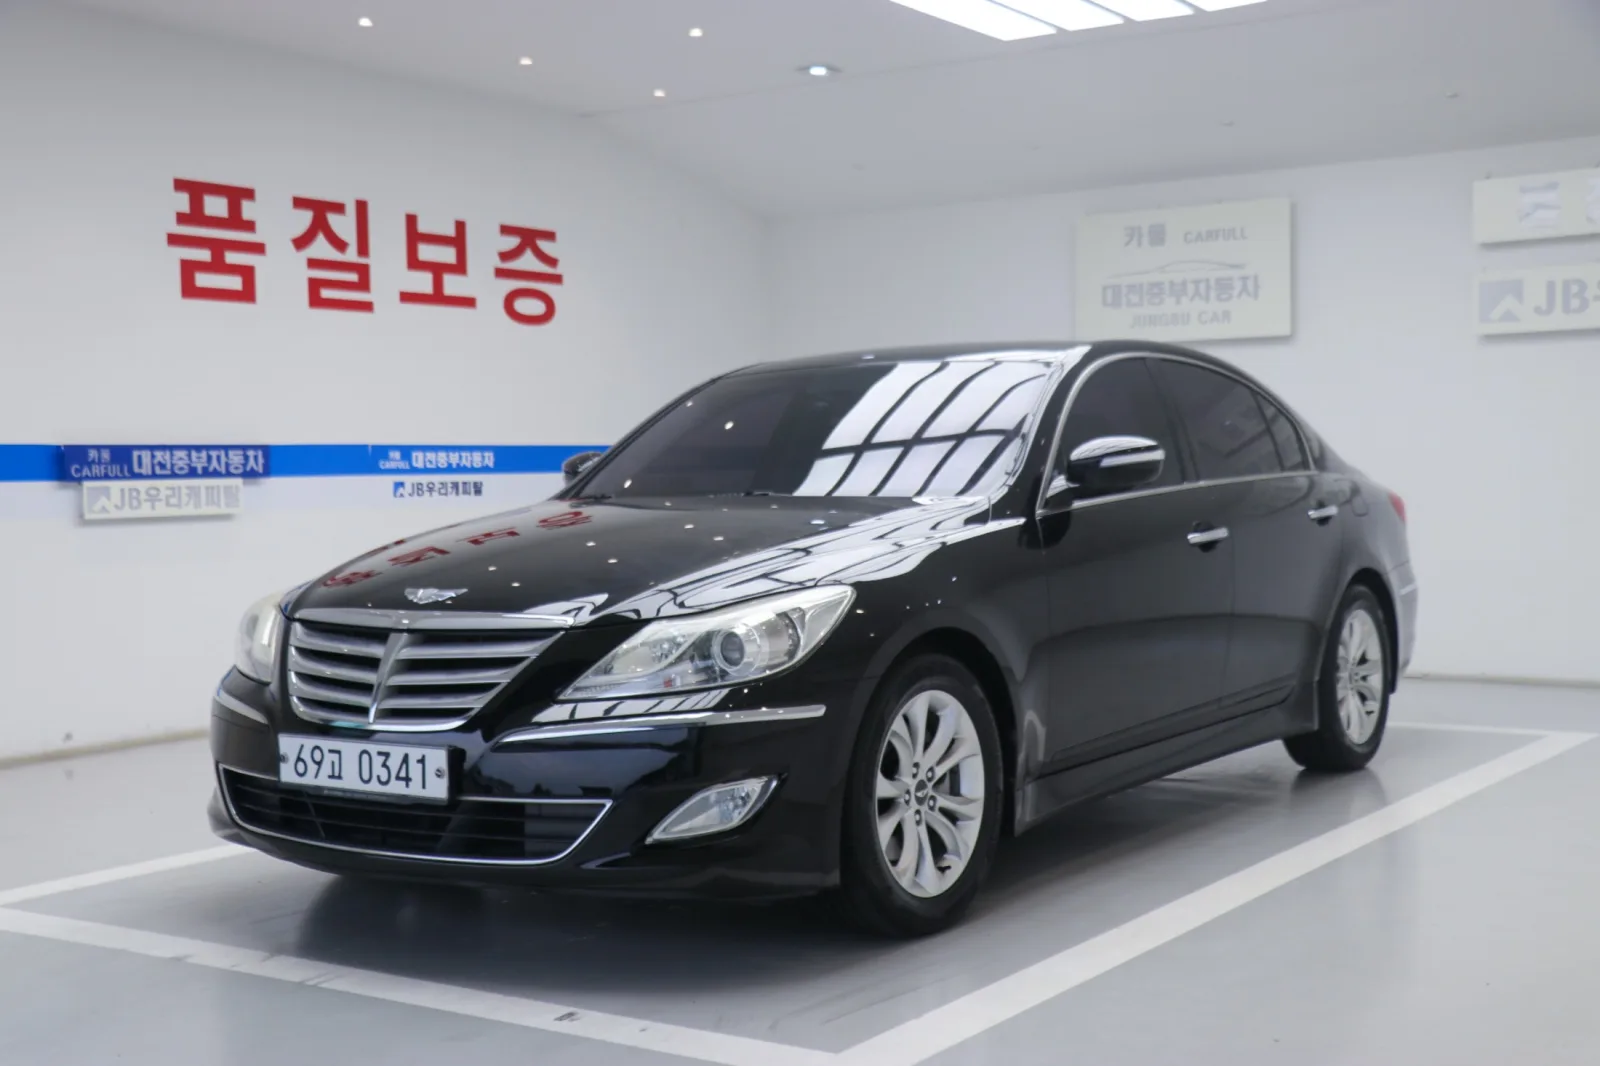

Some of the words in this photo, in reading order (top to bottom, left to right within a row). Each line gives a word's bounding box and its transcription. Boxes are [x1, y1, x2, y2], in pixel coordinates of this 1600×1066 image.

[1183, 226, 1249, 245] CARFULL
[166, 177, 563, 326] 품질보증
[1533, 278, 1600, 317] JB
[1197, 309, 1232, 326] CAR
[70, 464, 131, 478] CARFULL
[132, 449, 265, 475] 대전중부자동차
[294, 743, 343, 780] 69고
[358, 749, 428, 790] 0341
